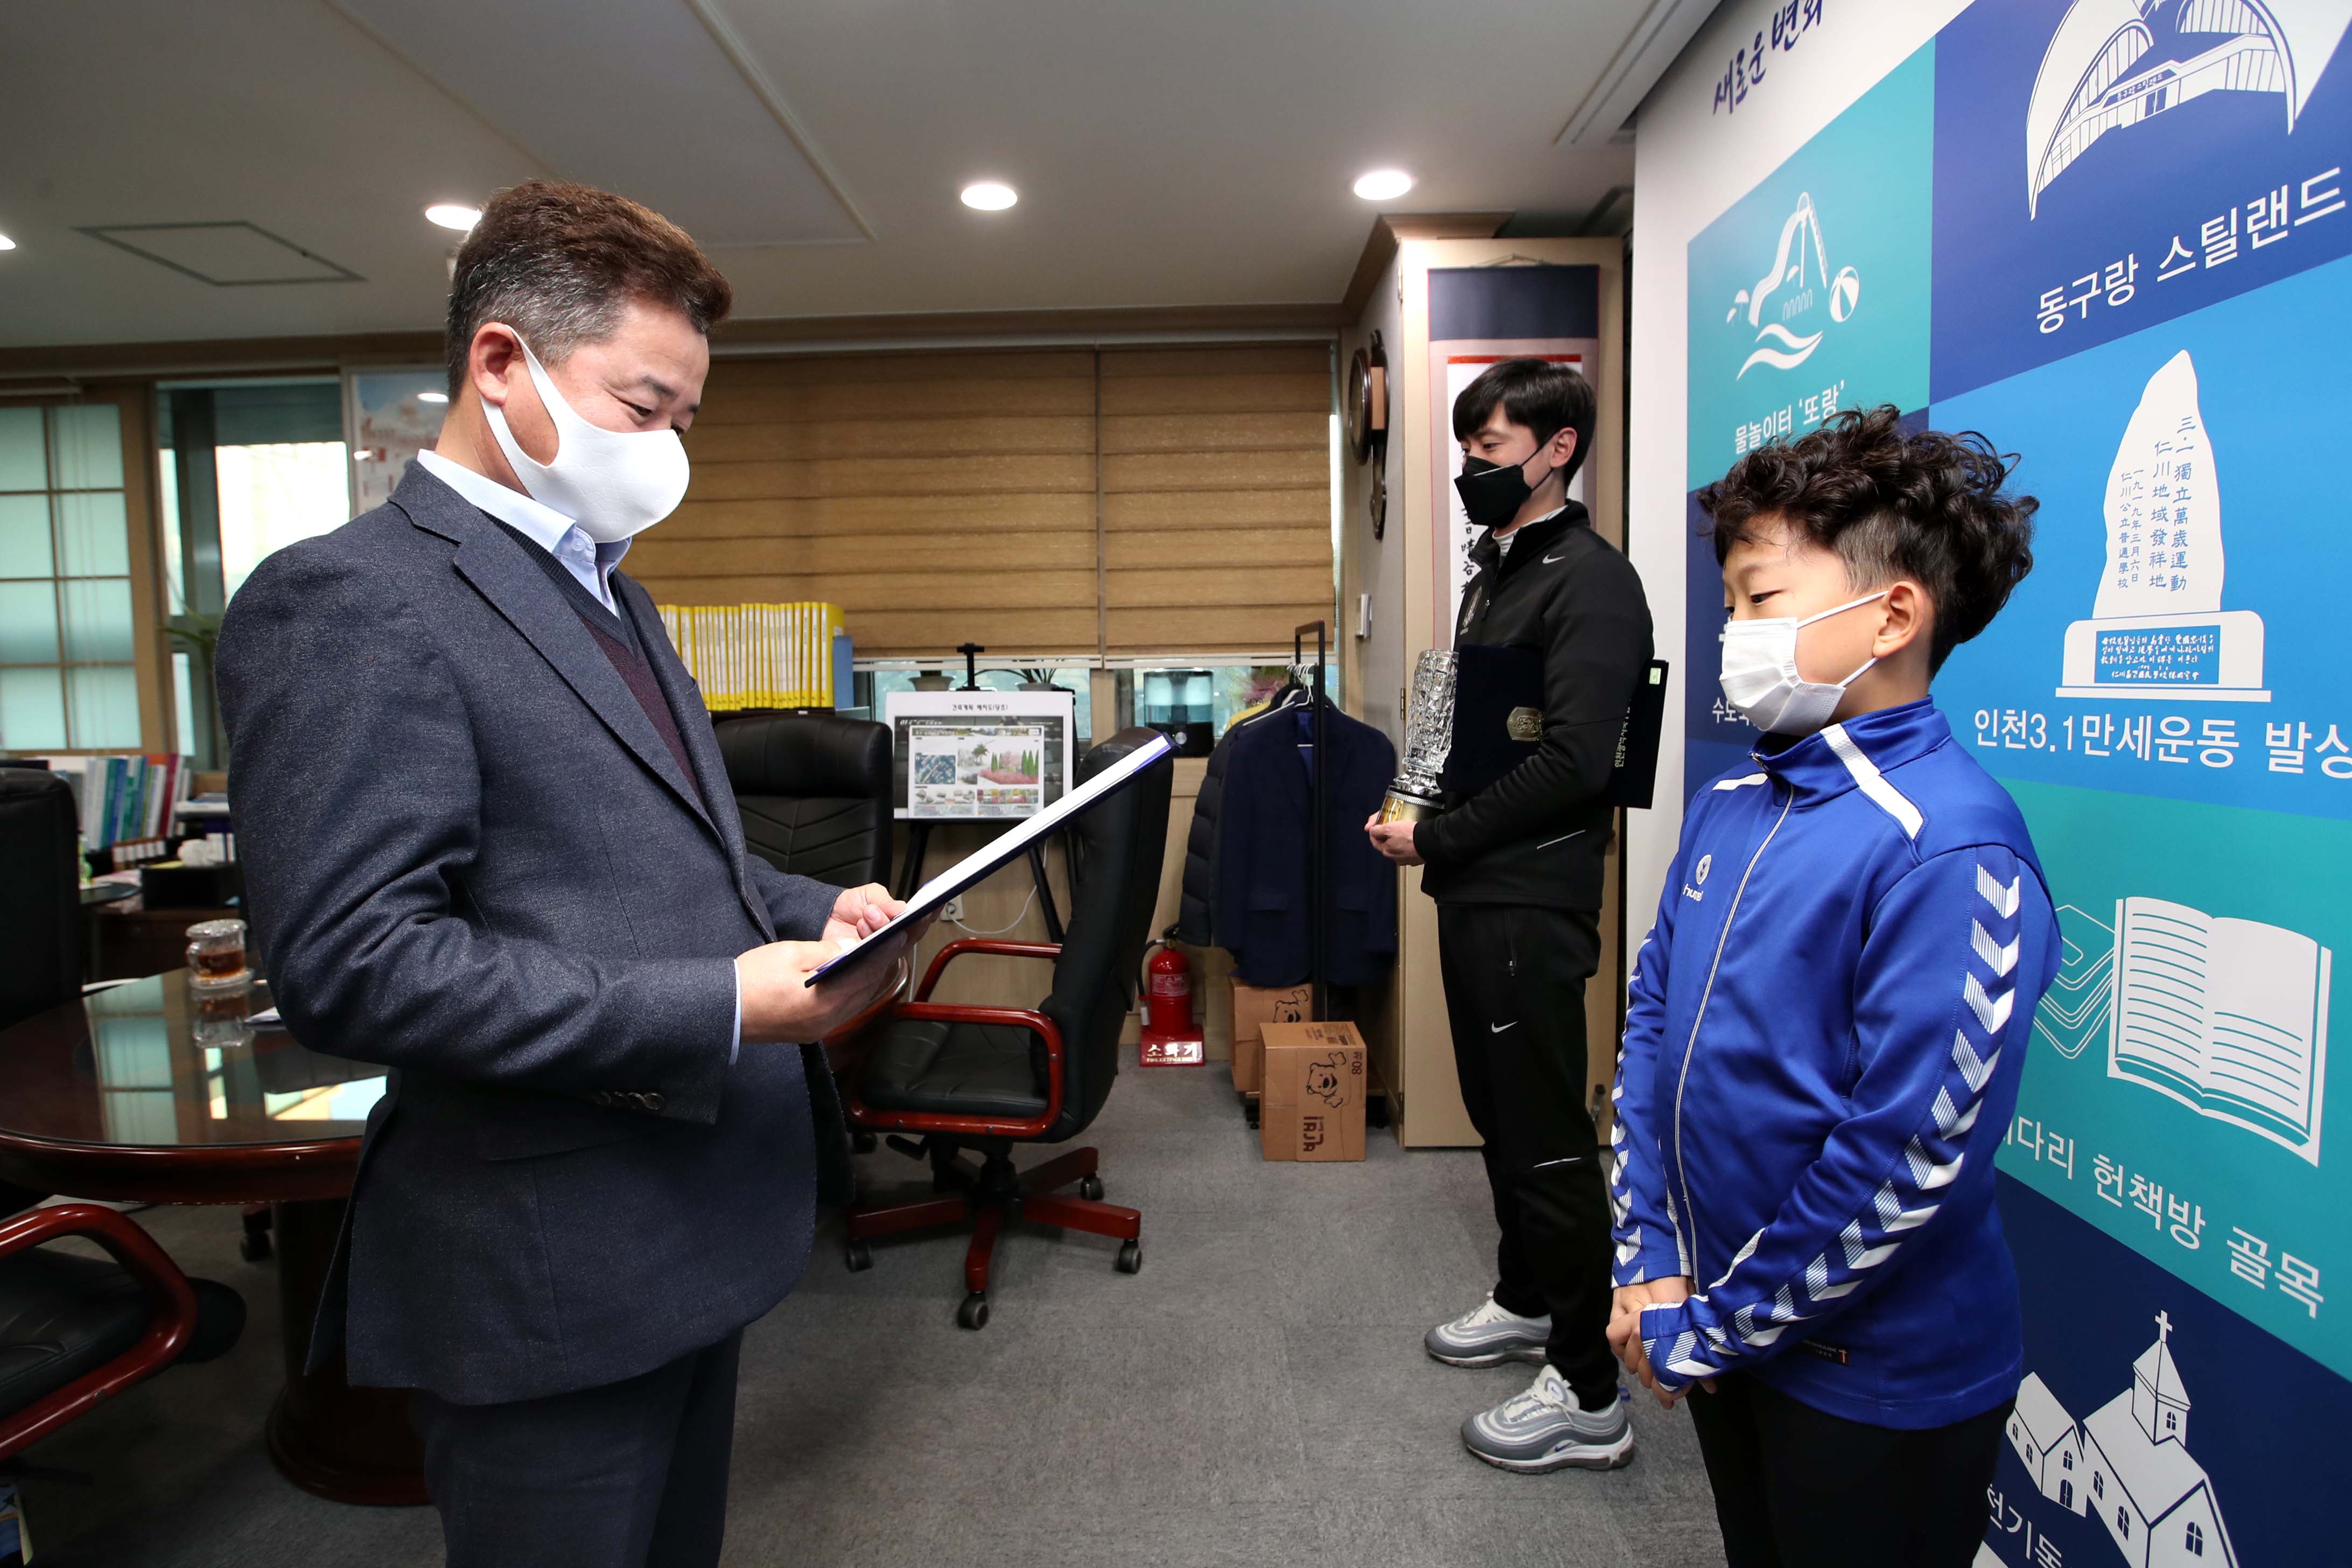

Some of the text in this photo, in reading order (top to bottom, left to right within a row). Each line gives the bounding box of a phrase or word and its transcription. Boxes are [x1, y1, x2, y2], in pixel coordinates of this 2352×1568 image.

[1713, 30, 1767, 115] 새로운
[2036, 166, 2346, 334] 동구랑 스틸랜드
[1735, 404, 1792, 454] 물놀이터
[1974, 708, 2240, 768] 인천3.1만세운동
[1147, 1042, 1197, 1058] 소화기
[2003, 1116, 2324, 1319] 다리 헌책방 골목
